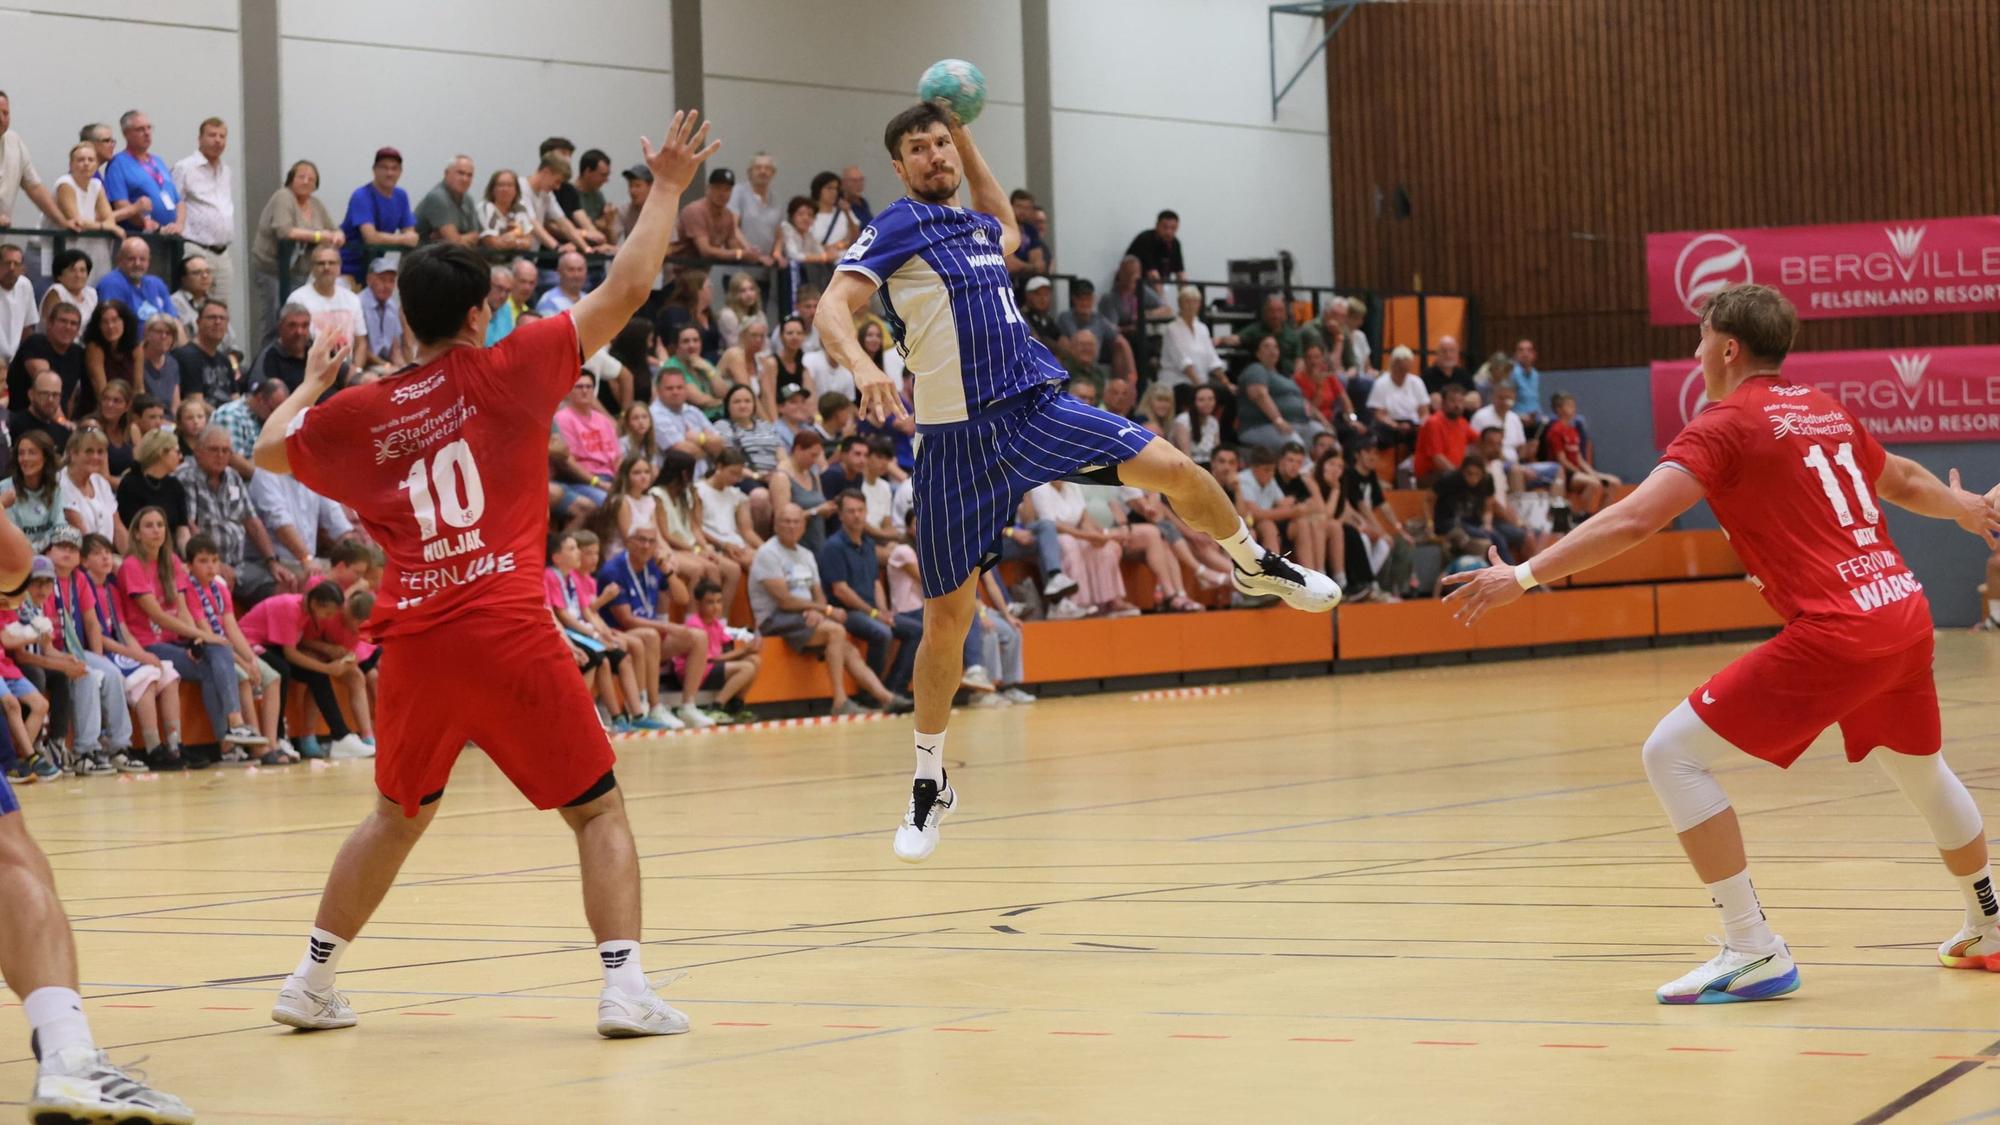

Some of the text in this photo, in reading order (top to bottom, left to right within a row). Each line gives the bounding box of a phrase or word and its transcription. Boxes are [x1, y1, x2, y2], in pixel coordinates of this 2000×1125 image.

[1780, 246, 2000, 285] BERGVILLE
[1811, 285, 1929, 309] FELSENLAND
[1939, 413, 2000, 433] RESOR
[398, 438, 486, 541] 10
[1803, 442, 1880, 528] 11
[423, 528, 486, 563] HULJAK
